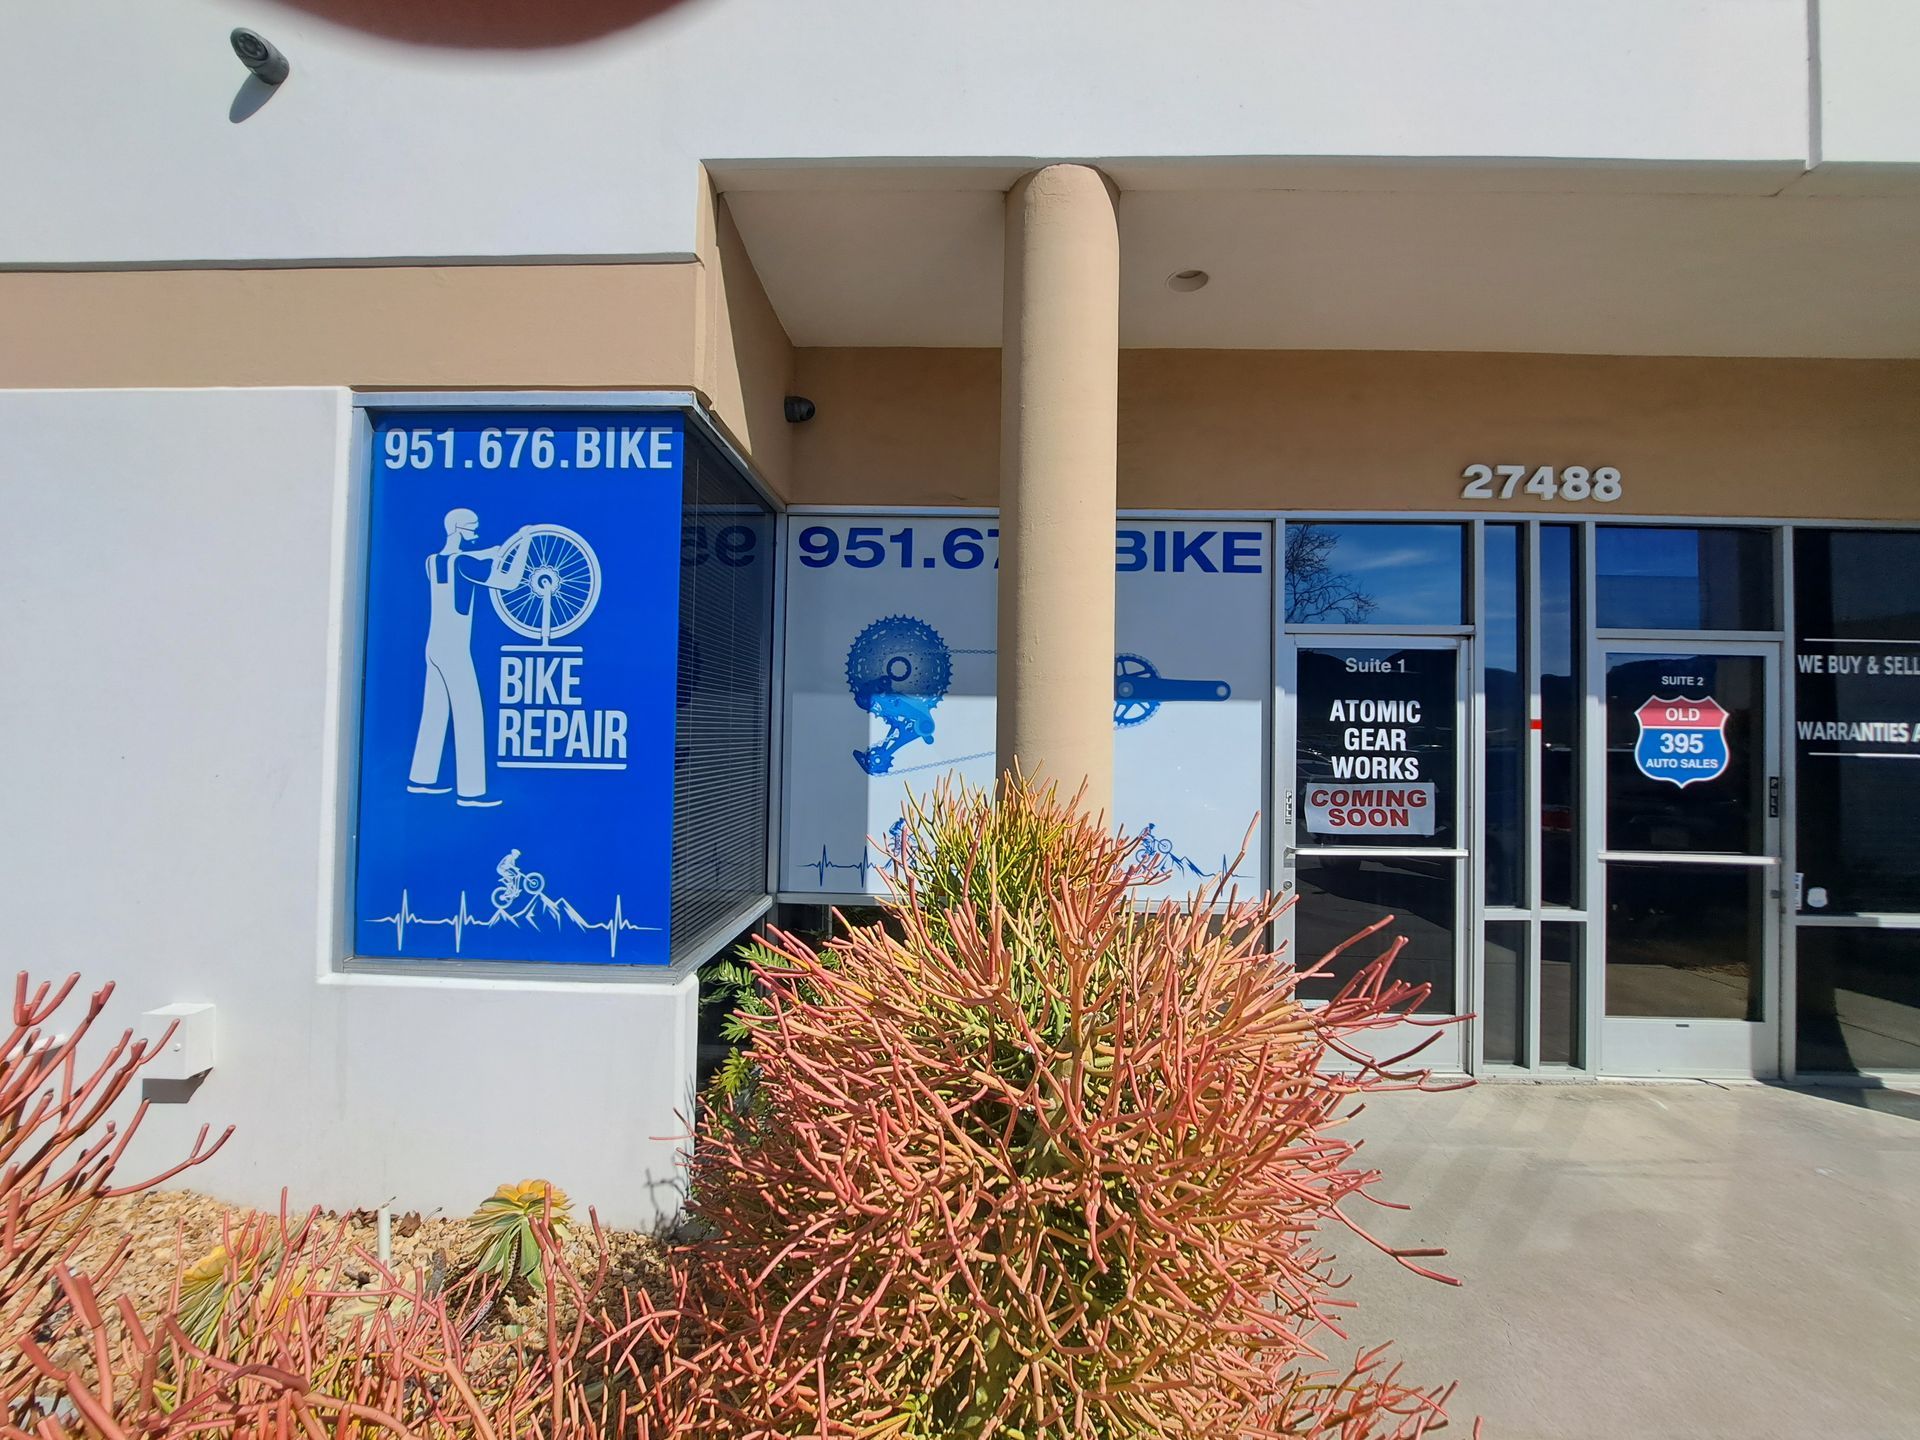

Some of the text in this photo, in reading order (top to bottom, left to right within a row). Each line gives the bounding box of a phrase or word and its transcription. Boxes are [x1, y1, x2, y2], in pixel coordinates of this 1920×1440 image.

[385, 427, 673, 469] 951.676.BIKE
[1460, 464, 1622, 502] 27488
[1345, 657, 1406, 673] Suite 1
[1797, 655, 1920, 675] WE BUY & SELL
[500, 657, 583, 705] BIKE
[1661, 676, 1704, 686] SUITE 2
[1329, 699, 1422, 723] ATOMIC
[1665, 708, 1700, 721] OLD
[497, 709, 628, 759] REPAIR
[1344, 728, 1407, 751] GEAR
[1797, 721, 1909, 743] WARRANTIES
[1660, 733, 1704, 754] 395
[1331, 756, 1419, 780] WORKS
[1645, 758, 1718, 769] AUTO SALES
[1311, 790, 1427, 807] COMING
[1328, 808, 1409, 827] SOON
